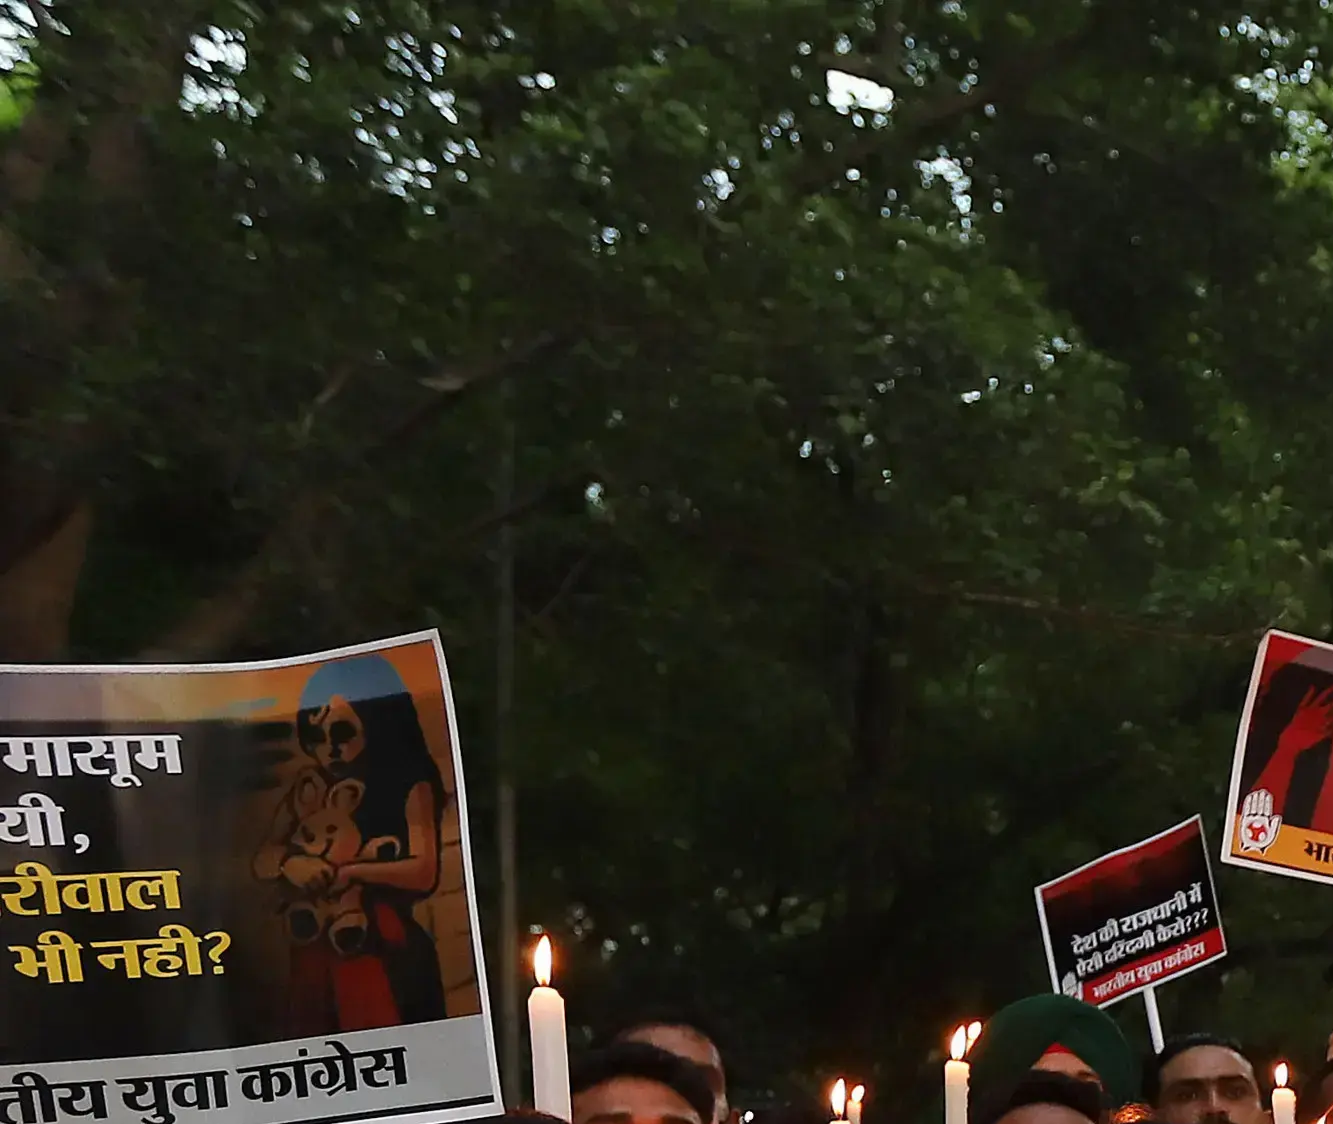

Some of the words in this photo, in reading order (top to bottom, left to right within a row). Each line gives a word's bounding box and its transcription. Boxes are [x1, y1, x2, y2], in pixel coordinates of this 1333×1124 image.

[0, 734, 183, 788] मासूम
[1071, 934, 1097, 955] देश
[1099, 918, 1120, 943] की
[1187, 882, 1202, 903] में
[8, 930, 84, 984] भी
[90, 925, 232, 980] नही?
[236, 1040, 408, 1103] कांग्रेस
